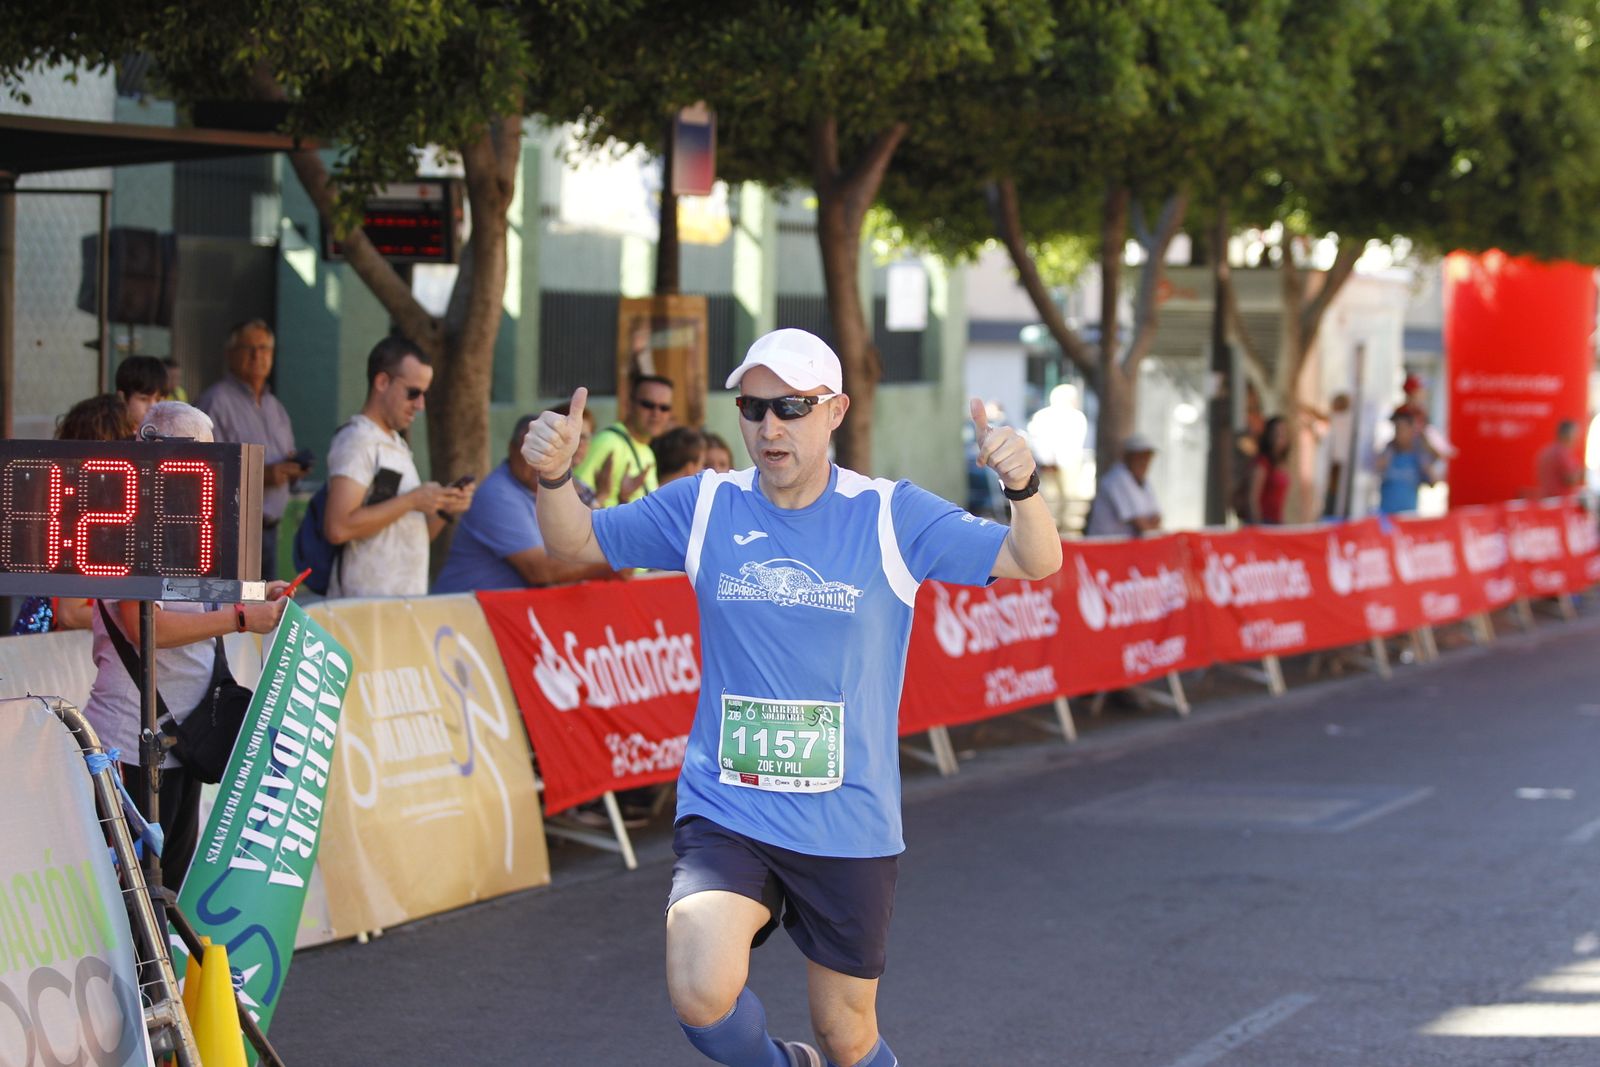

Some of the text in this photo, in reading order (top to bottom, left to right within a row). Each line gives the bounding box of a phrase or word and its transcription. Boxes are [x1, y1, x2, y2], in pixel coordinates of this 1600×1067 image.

[49, 460, 215, 577] 1:27
[802, 590, 851, 607] RUNNING
[205, 620, 300, 865] POR LAS ENFERMEDADES POCO FRECUENTES
[228, 630, 324, 872] SOLIDARIA
[731, 726, 820, 760] 1157
[757, 759, 802, 774] ZOE Y PILI
[761, 704, 805, 714] CARRERA
[267, 651, 348, 888] CARRERA
[0, 848, 117, 975] ACIÓN
